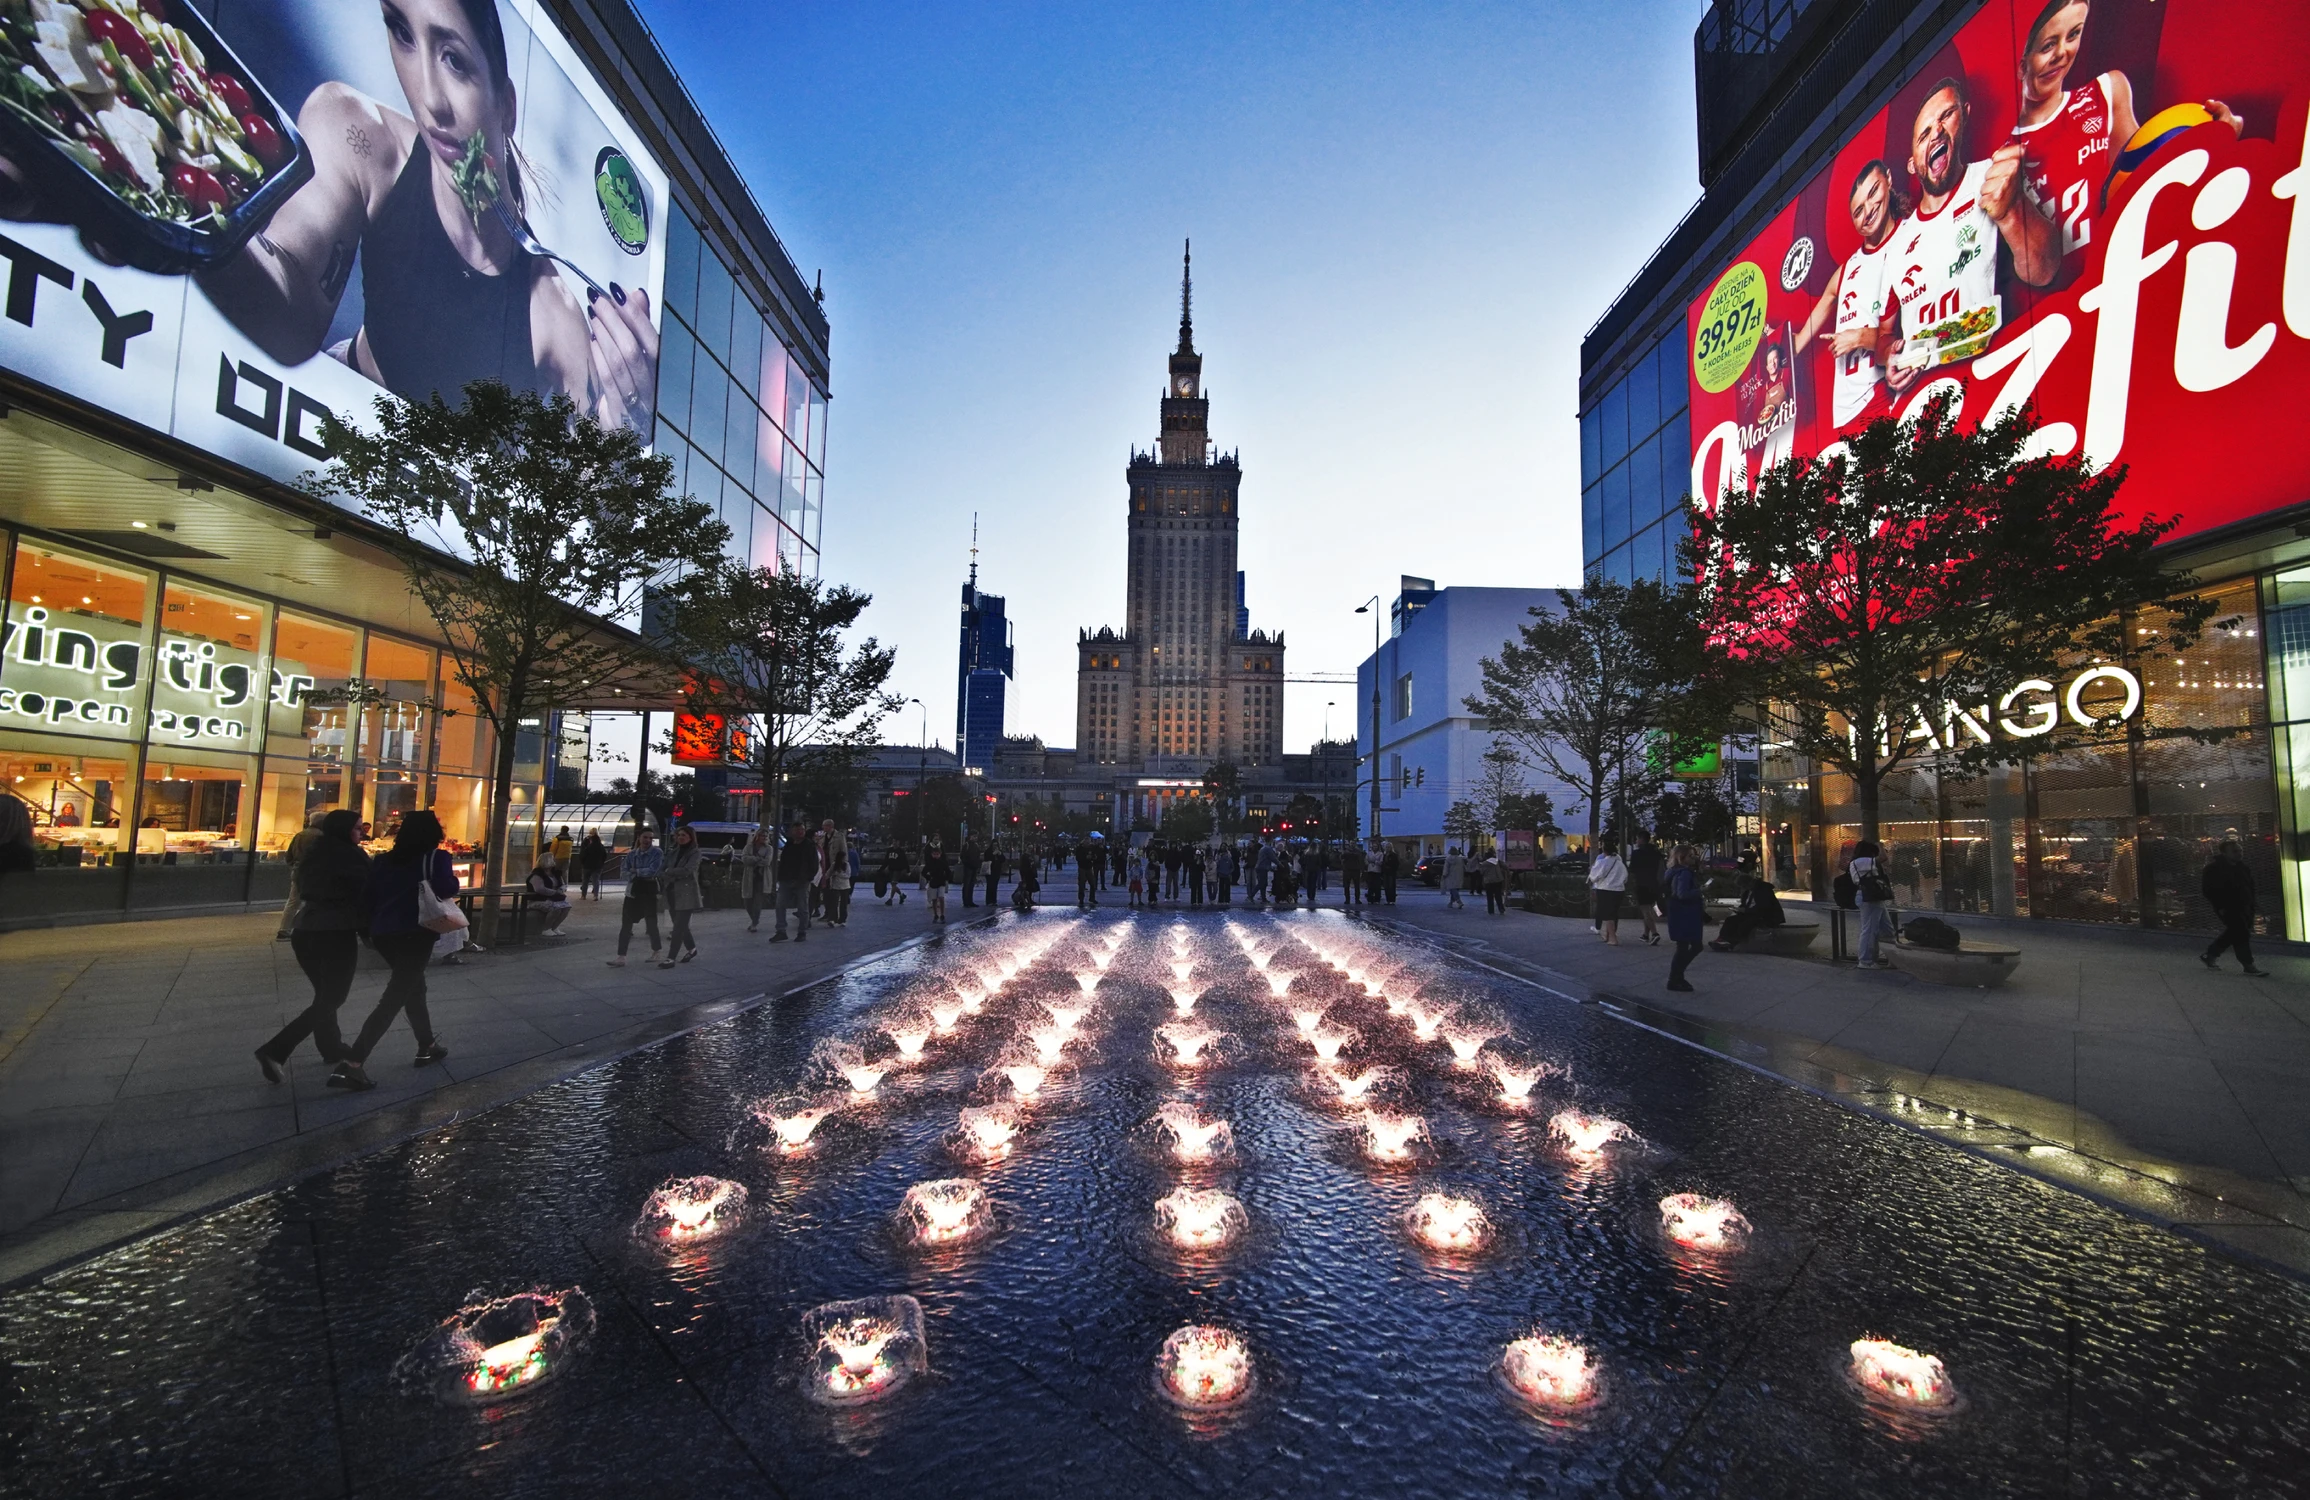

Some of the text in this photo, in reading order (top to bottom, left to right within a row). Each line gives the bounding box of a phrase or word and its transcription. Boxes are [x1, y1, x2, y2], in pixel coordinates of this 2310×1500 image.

[2078, 138, 2109, 165] plus
[1710, 269, 1755, 311] CAŁY DZIEŃ
[1731, 290, 1746, 308] OD
[1901, 283, 1927, 306] ORLEN
[1737, 398, 1797, 456] Maczfit
